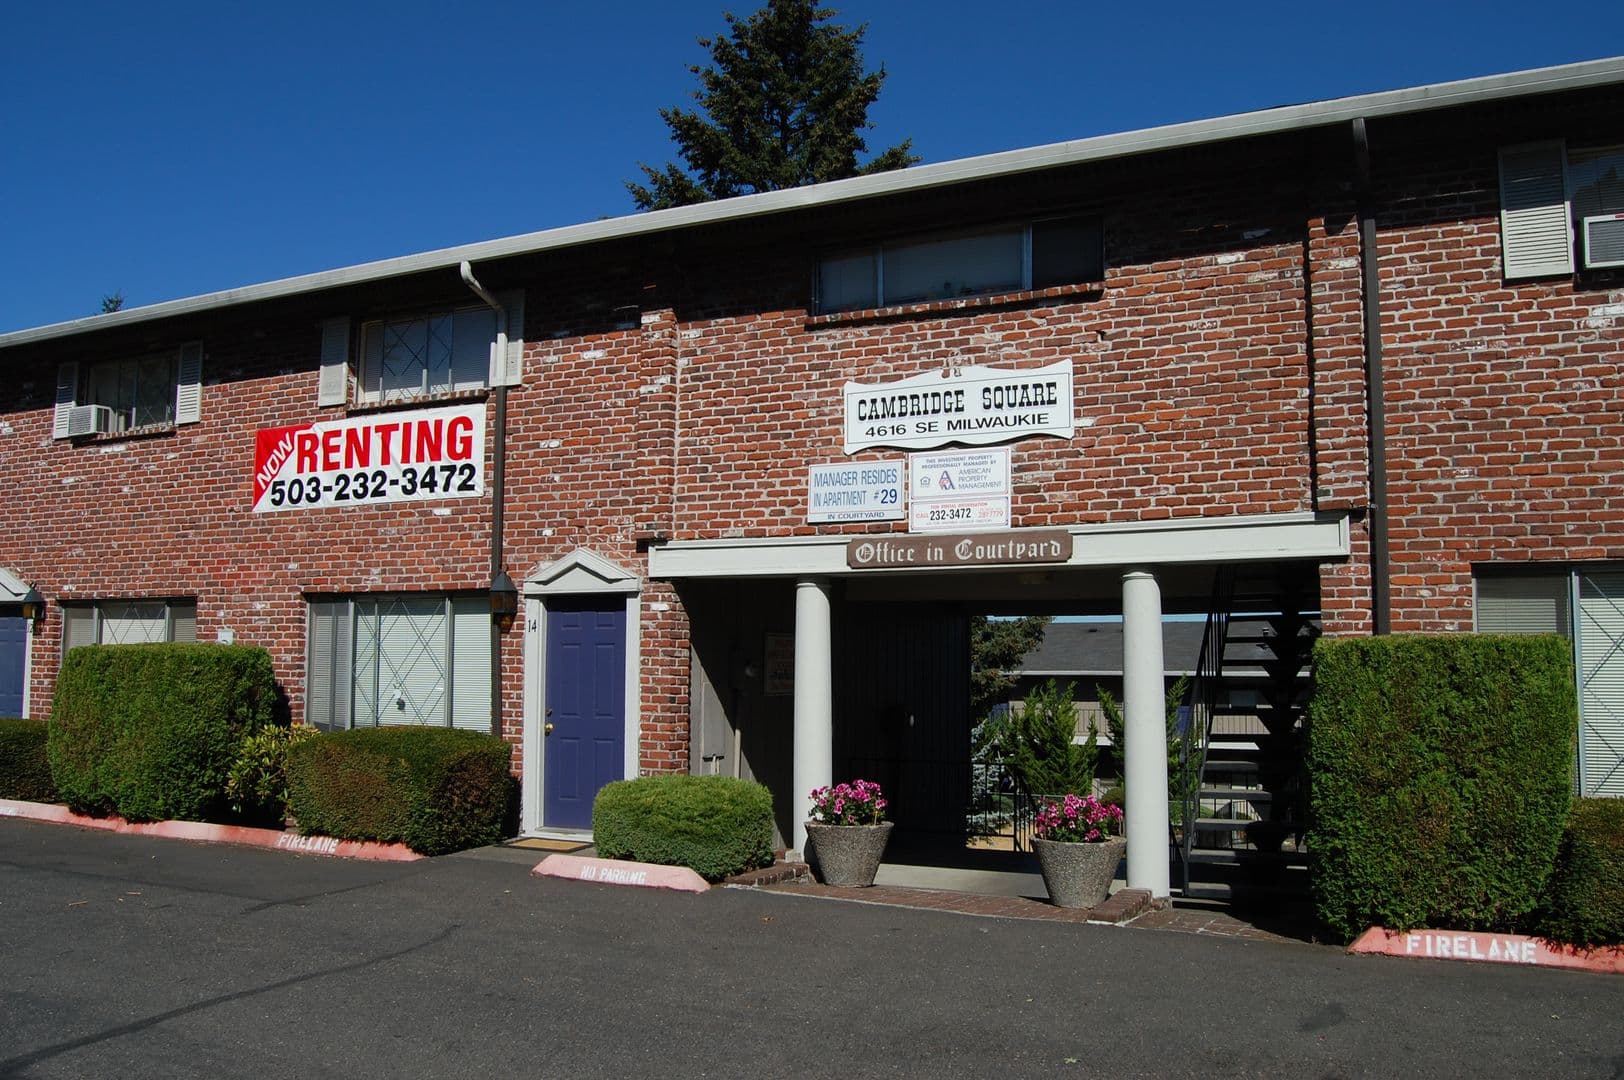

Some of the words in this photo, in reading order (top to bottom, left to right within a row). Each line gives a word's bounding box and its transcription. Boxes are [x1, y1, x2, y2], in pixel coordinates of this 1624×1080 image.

[858, 389, 965, 421] CAMBRIDGE
[982, 382, 1057, 410] SQUARE
[865, 424, 907, 437] 4616
[915, 422, 939, 433] SE
[947, 413, 1049, 431] MILWAUKIE
[296, 416, 473, 474] RENTING
[256, 432, 293, 489] NOW
[271, 463, 476, 506] 503-232-3472
[814, 471, 858, 487] MANAGER
[861, 468, 897, 485] RESIDES
[958, 481, 1002, 490] MANAGEMENT
[814, 492, 821, 507] IN
[823, 490, 867, 506] APARTMENT
[930, 508, 971, 521] 232-3472
[855, 542, 915, 563] Office
[927, 542, 944, 561] in
[954, 539, 1061, 561] Courtyard
[528, 619, 537, 632] 14
[580, 865, 596, 879] NO
[600, 868, 647, 884] PARKING
[1406, 935, 1537, 964] FIRELANE
